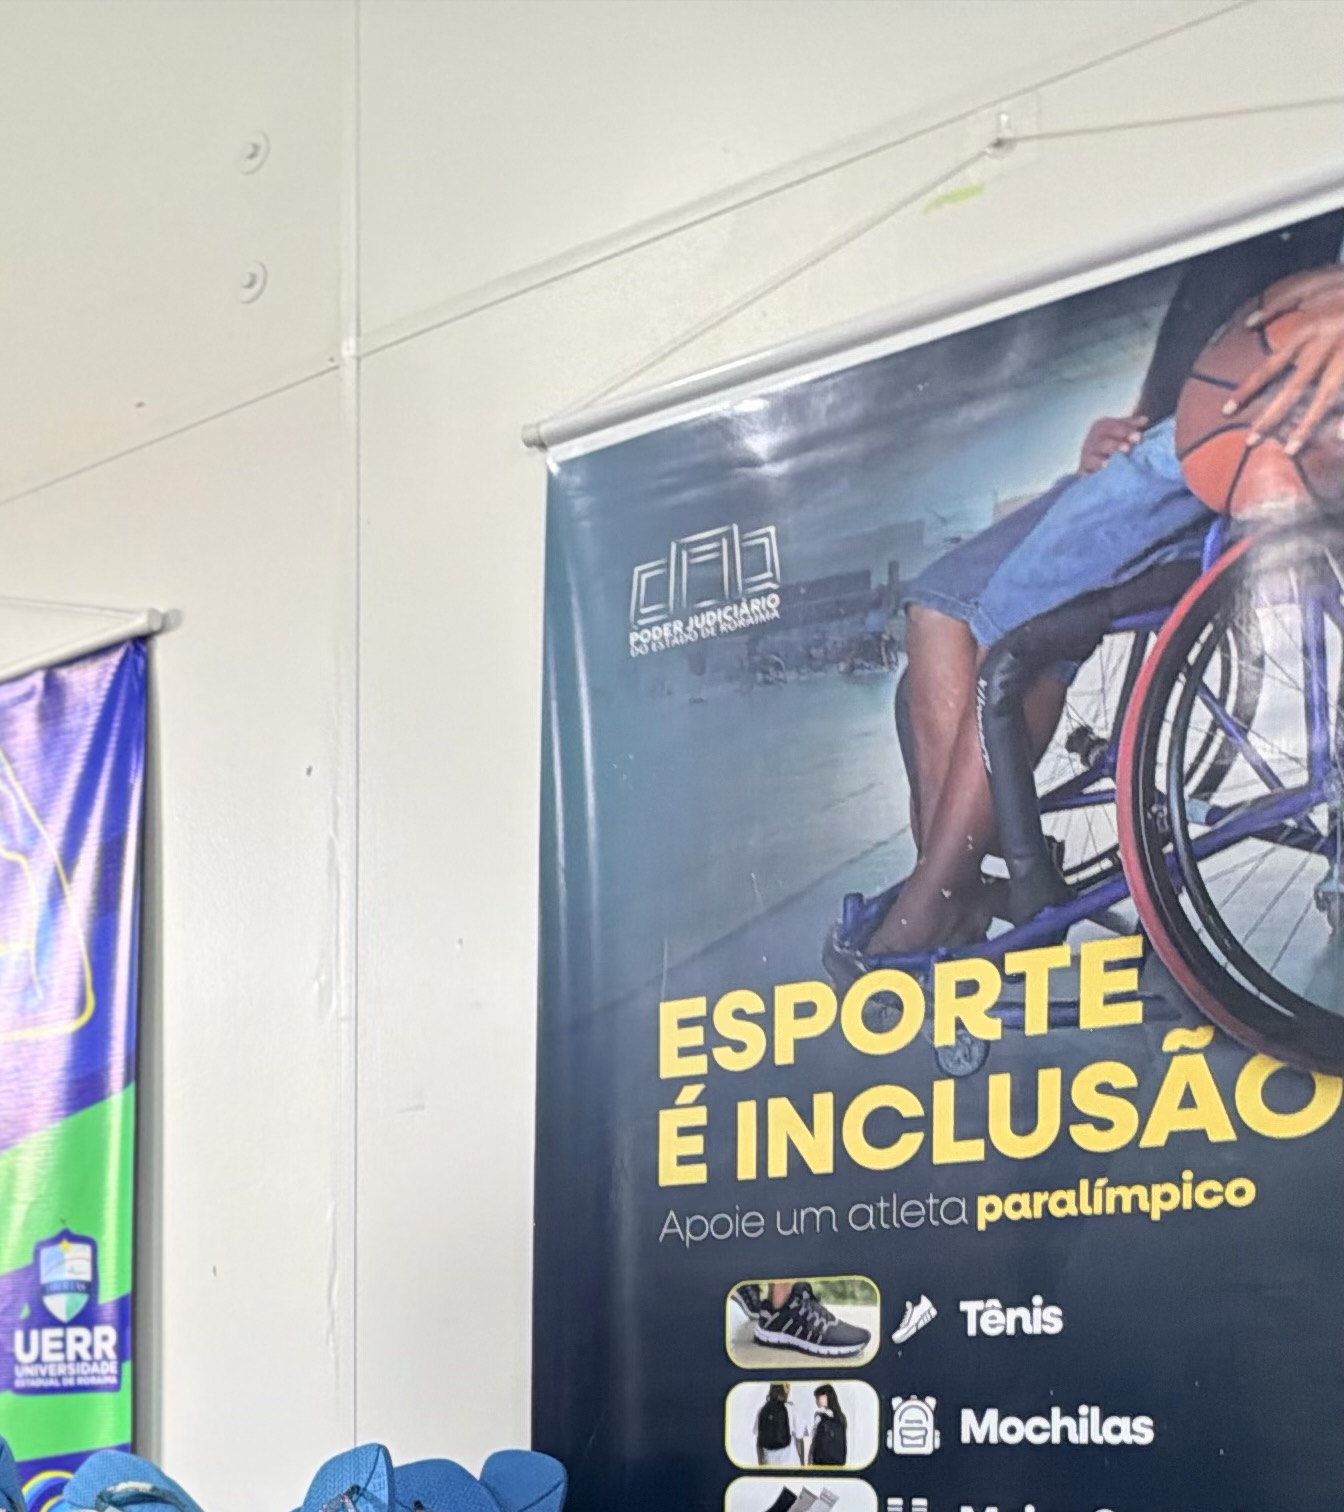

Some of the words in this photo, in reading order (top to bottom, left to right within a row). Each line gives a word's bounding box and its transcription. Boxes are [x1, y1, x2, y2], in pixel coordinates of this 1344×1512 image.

[629, 619, 684, 647] PODER
[686, 592, 781, 634] JUDICIÁRIO
[658, 934, 1145, 1080] ESPORTE
[656, 1084, 708, 1188] É
[735, 1024, 1344, 1182] INCLUSÃO
[659, 1204, 765, 1248] Apoie
[776, 1205, 839, 1234] um
[848, 1191, 969, 1232] atleta
[976, 1169, 1257, 1231] paralímpico
[959, 1294, 1064, 1337] Tênis
[13, 1324, 118, 1364] UERR
[14, 1360, 118, 1378] UNIVERSIDADE
[960, 1404, 1155, 1447] Mochilas
